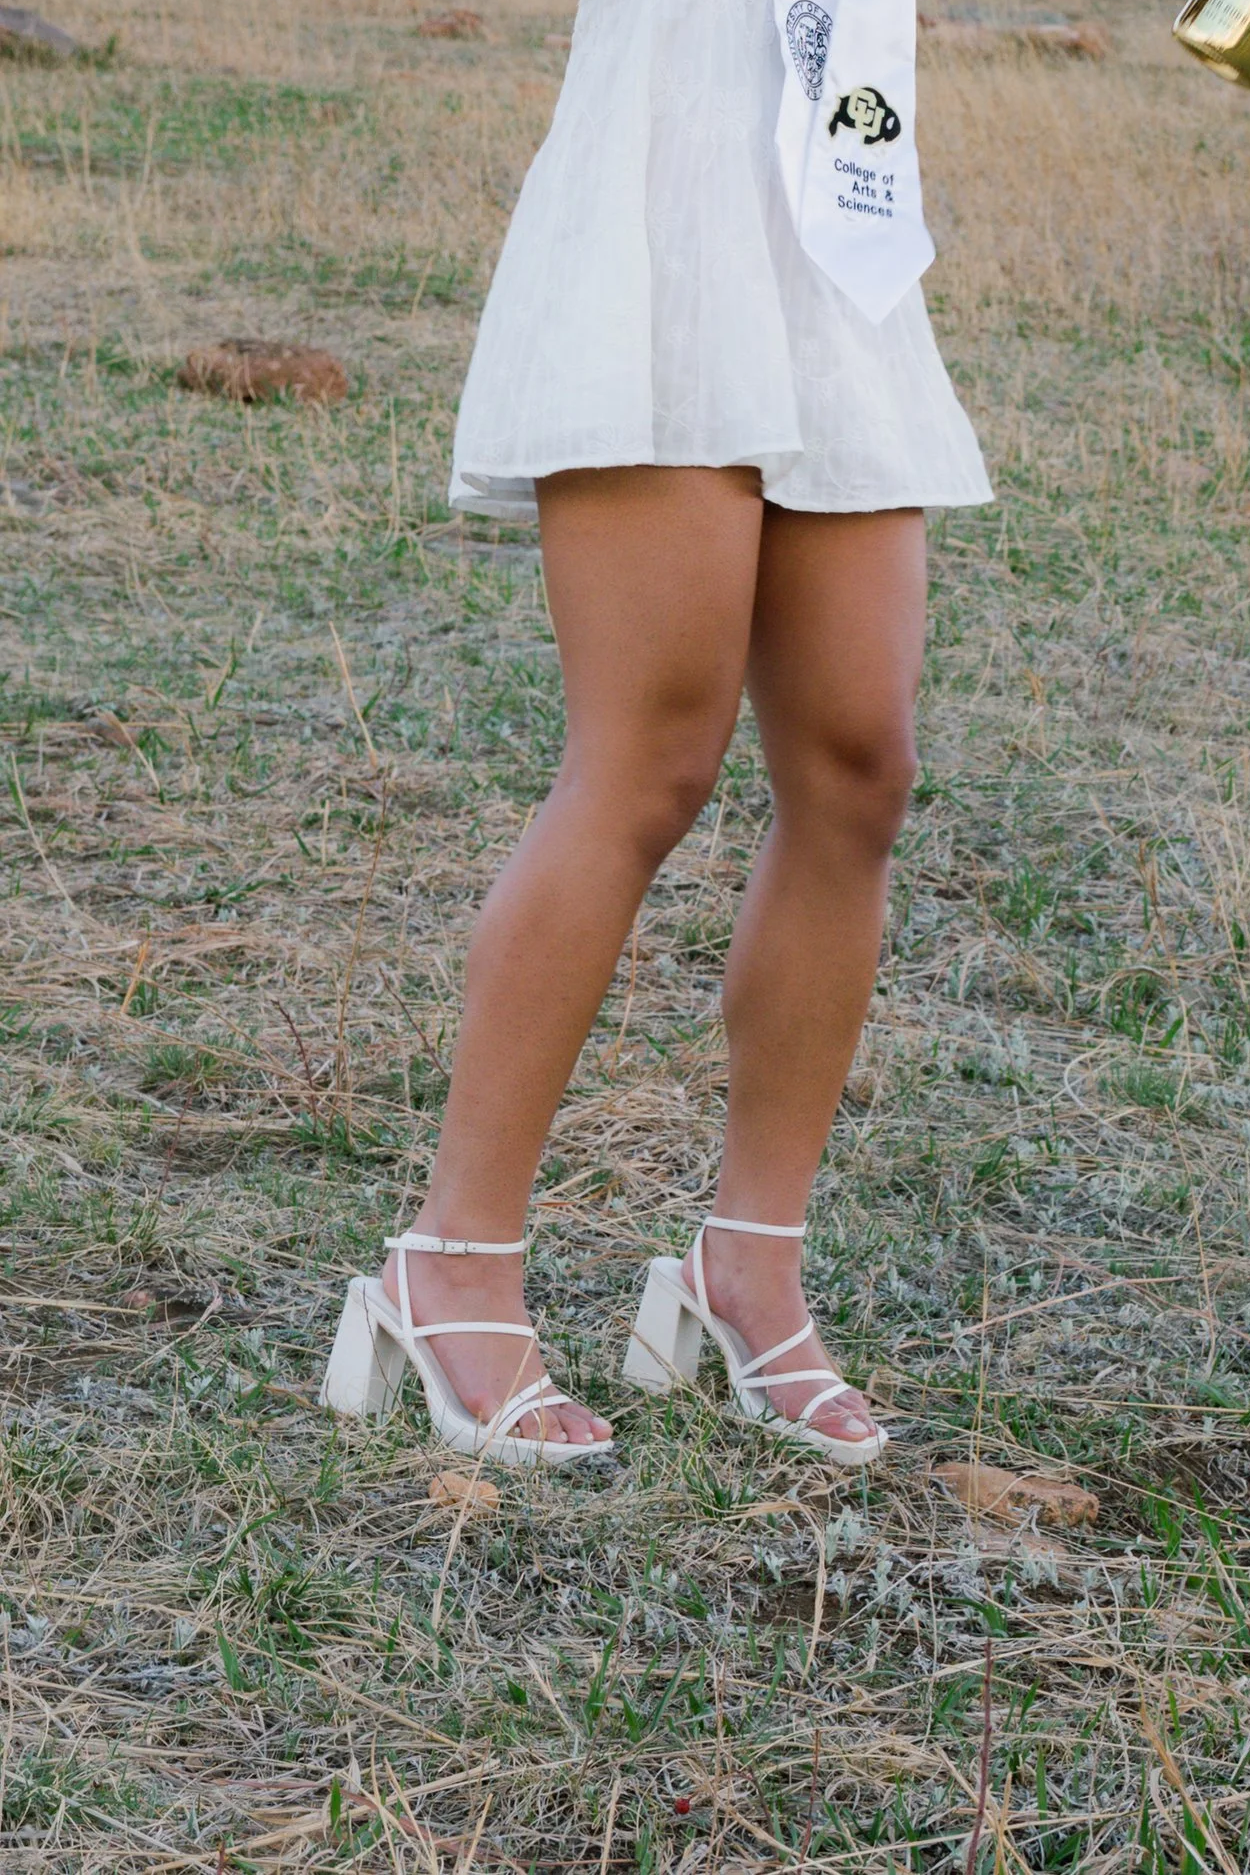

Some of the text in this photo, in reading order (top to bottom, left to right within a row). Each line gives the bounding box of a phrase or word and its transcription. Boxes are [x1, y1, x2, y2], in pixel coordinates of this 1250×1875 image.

[807, 3, 819, 14] OF
[847, 87, 886, 138] CU
[834, 158, 894, 186] College of
[852, 181, 894, 202] Arts &
[837, 195, 893, 218] Sciences
